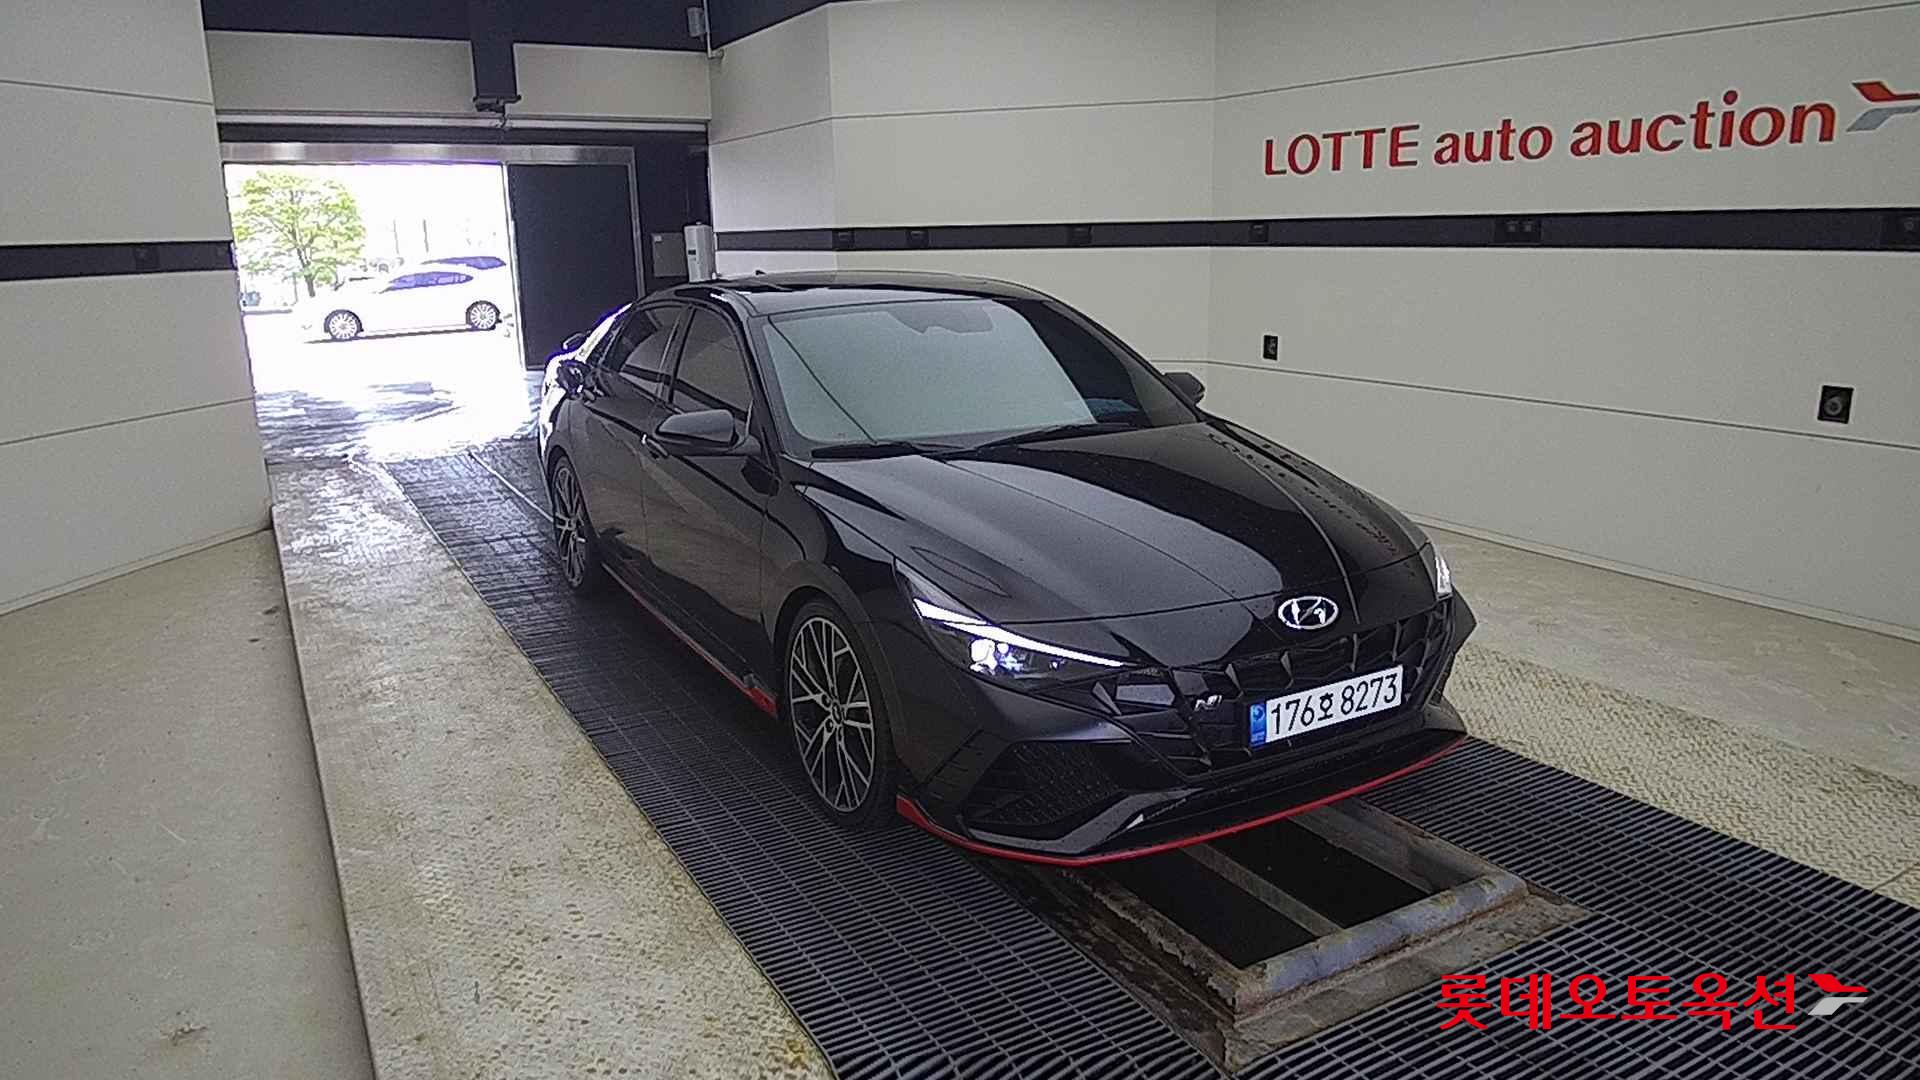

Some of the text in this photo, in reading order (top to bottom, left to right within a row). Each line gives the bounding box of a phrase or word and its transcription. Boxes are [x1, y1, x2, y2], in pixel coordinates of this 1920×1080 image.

[1265, 90, 1836, 176] LOTTE auto auction
[1270, 673, 1399, 736] 176호 8273
